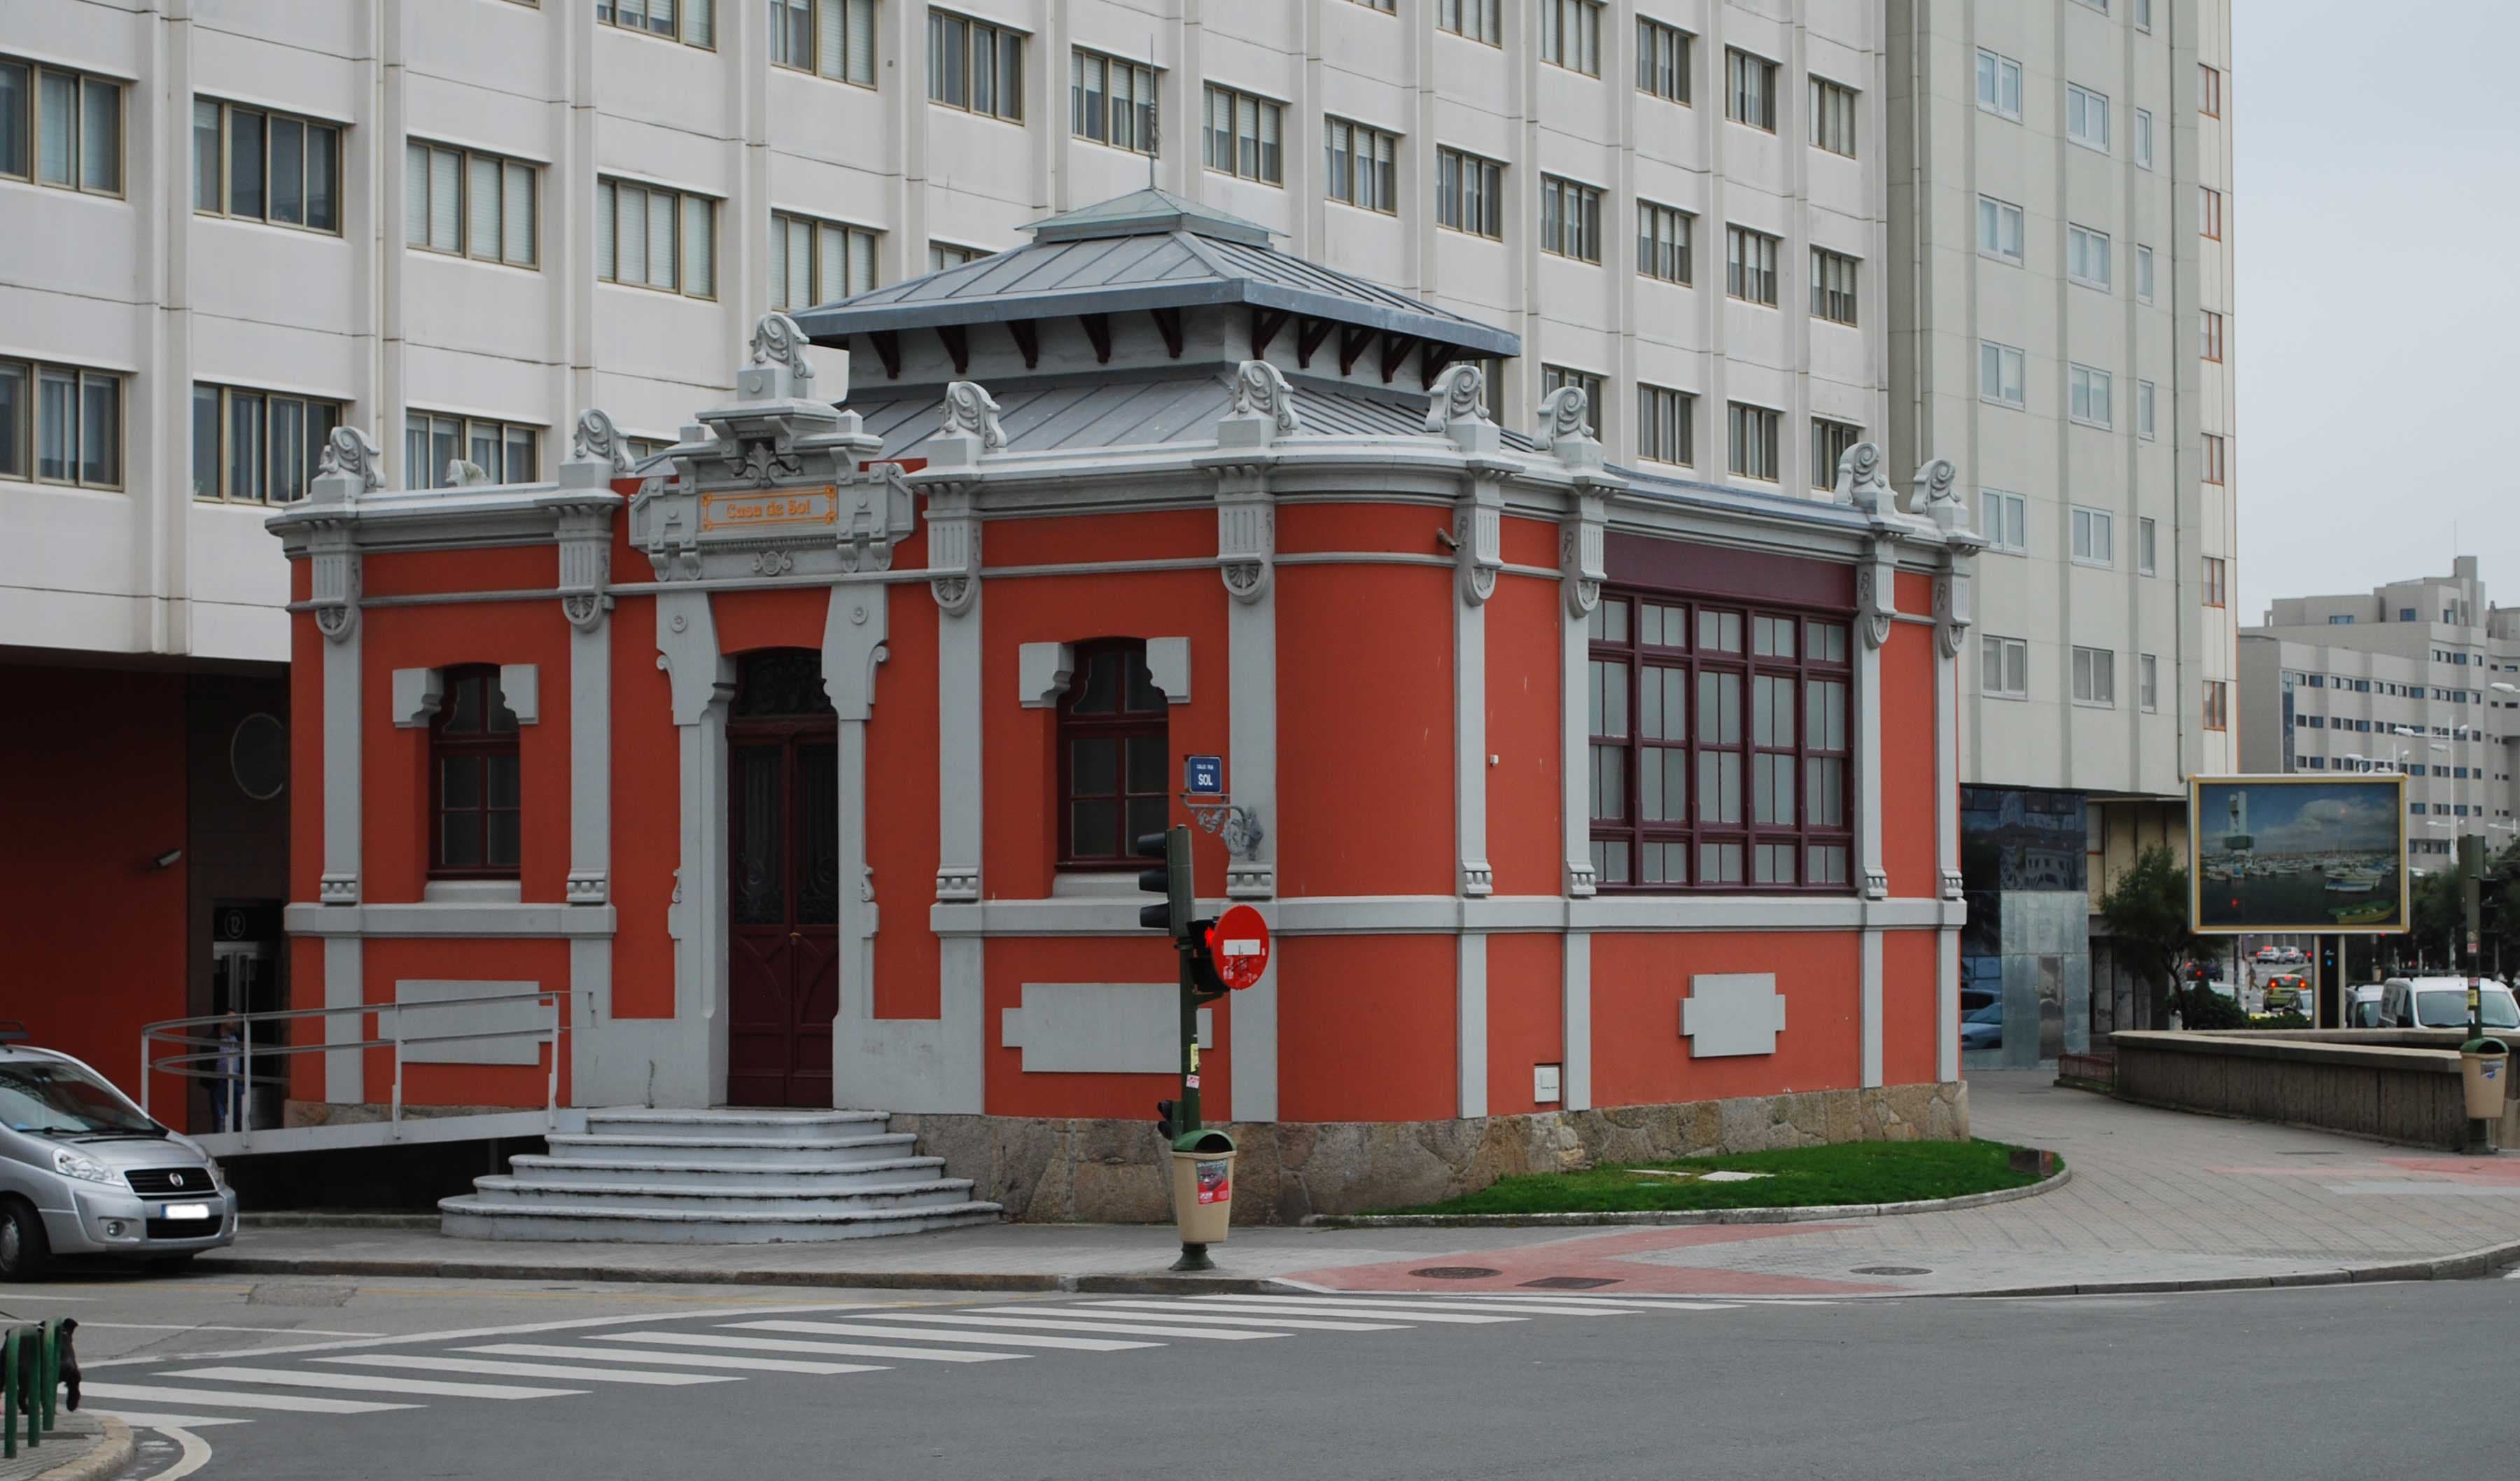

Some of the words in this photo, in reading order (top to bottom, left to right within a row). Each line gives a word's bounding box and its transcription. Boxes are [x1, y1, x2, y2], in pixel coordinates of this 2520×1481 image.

[727, 503, 762, 518] Casa
[766, 500, 783, 516] de
[788, 499, 811, 515] Sol
[1198, 773, 1213, 785] SOL
